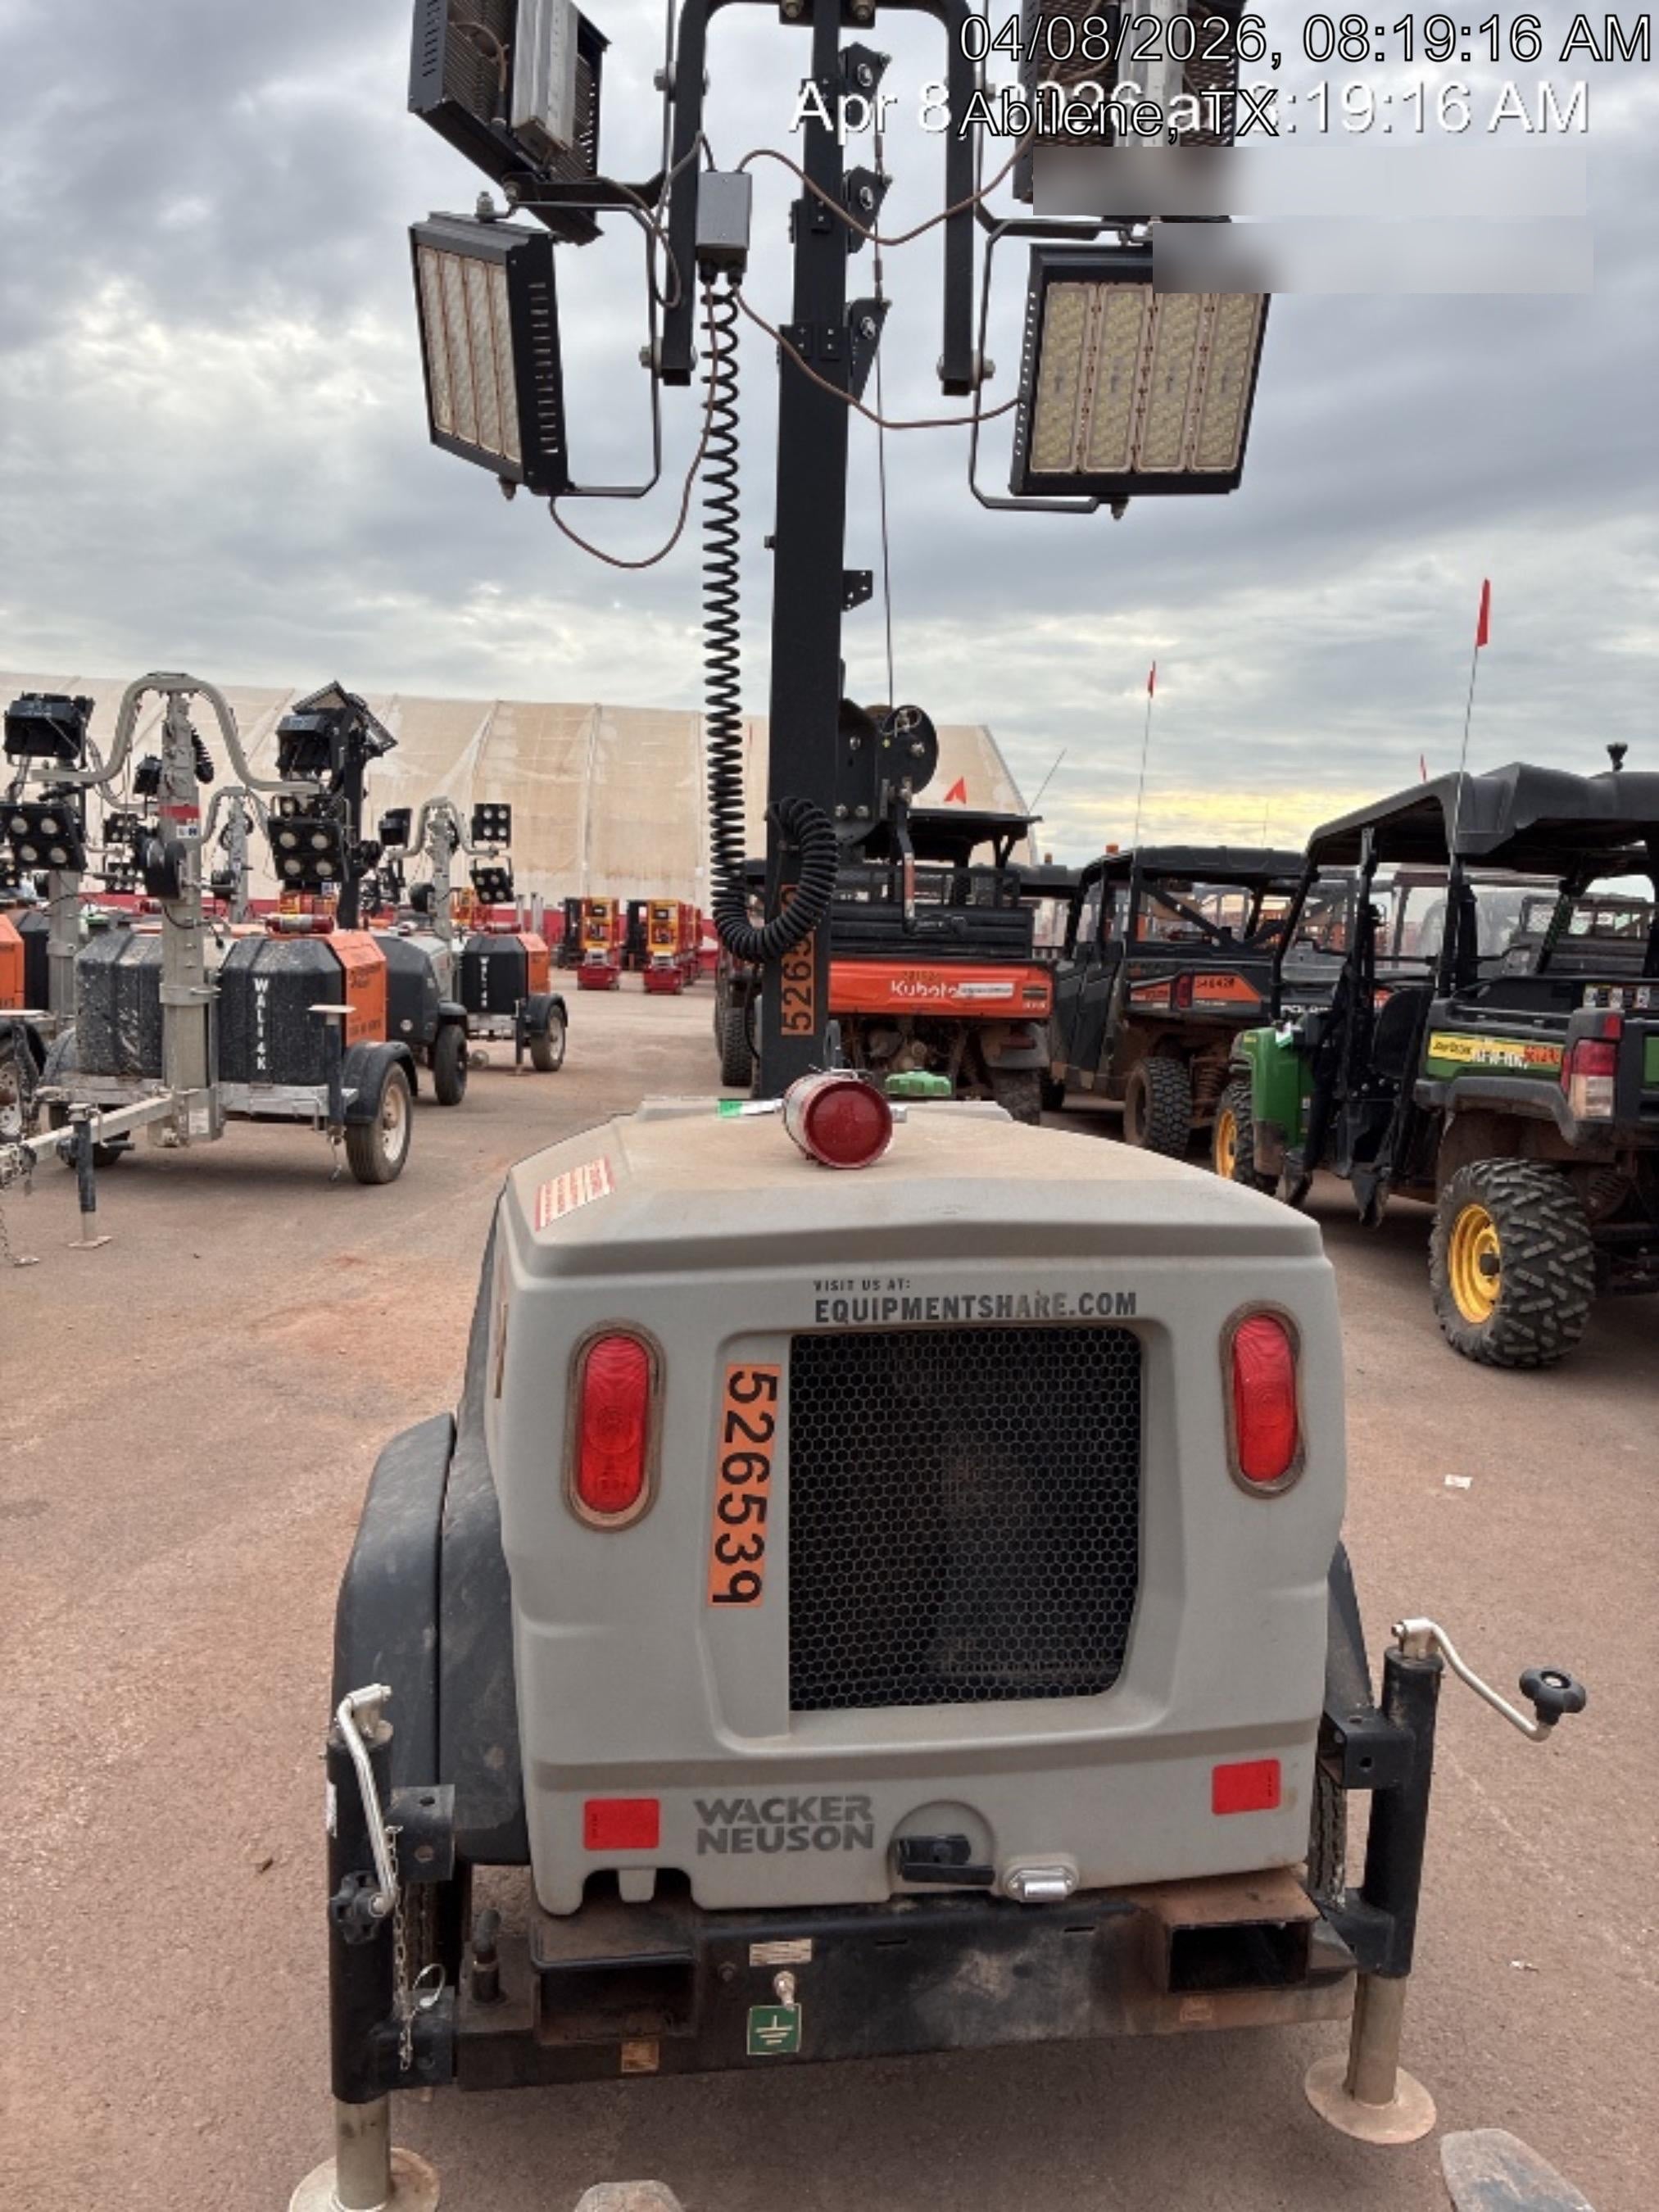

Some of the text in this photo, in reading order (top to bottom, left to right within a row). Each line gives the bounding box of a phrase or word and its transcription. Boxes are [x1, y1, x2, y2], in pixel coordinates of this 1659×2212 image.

[813, 1278, 911, 1292] VISIT US AT:
[815, 1291, 1137, 1326] EQUIPMENTSHARE.COM
[711, 1369, 778, 1604] 526539
[693, 1794, 874, 1826] WACKER
[696, 1823, 875, 1856] NEUSON
